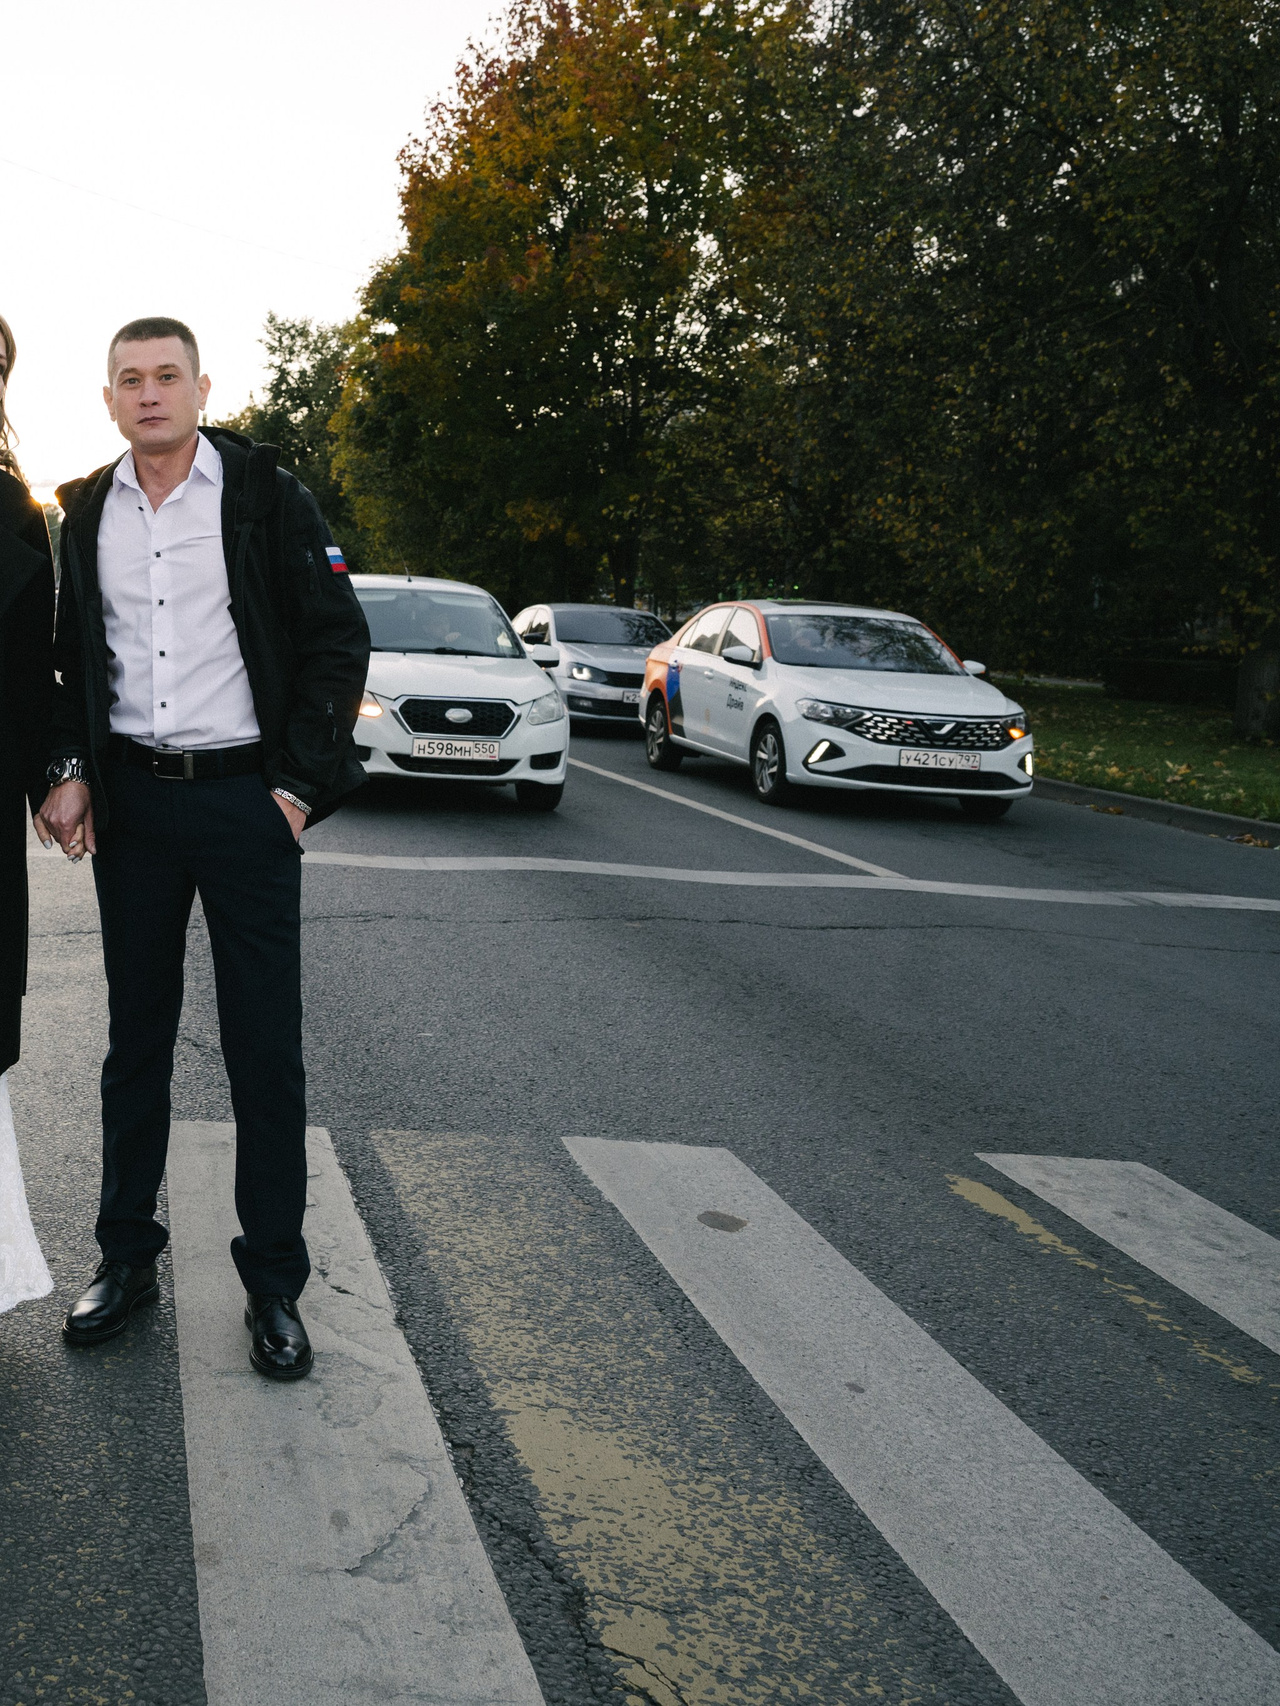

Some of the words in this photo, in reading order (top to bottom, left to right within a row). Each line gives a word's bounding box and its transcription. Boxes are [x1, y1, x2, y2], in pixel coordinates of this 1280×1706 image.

[626, 693, 640, 702] К2
[474, 743, 495, 754] 550
[958, 754, 977, 764] 797
